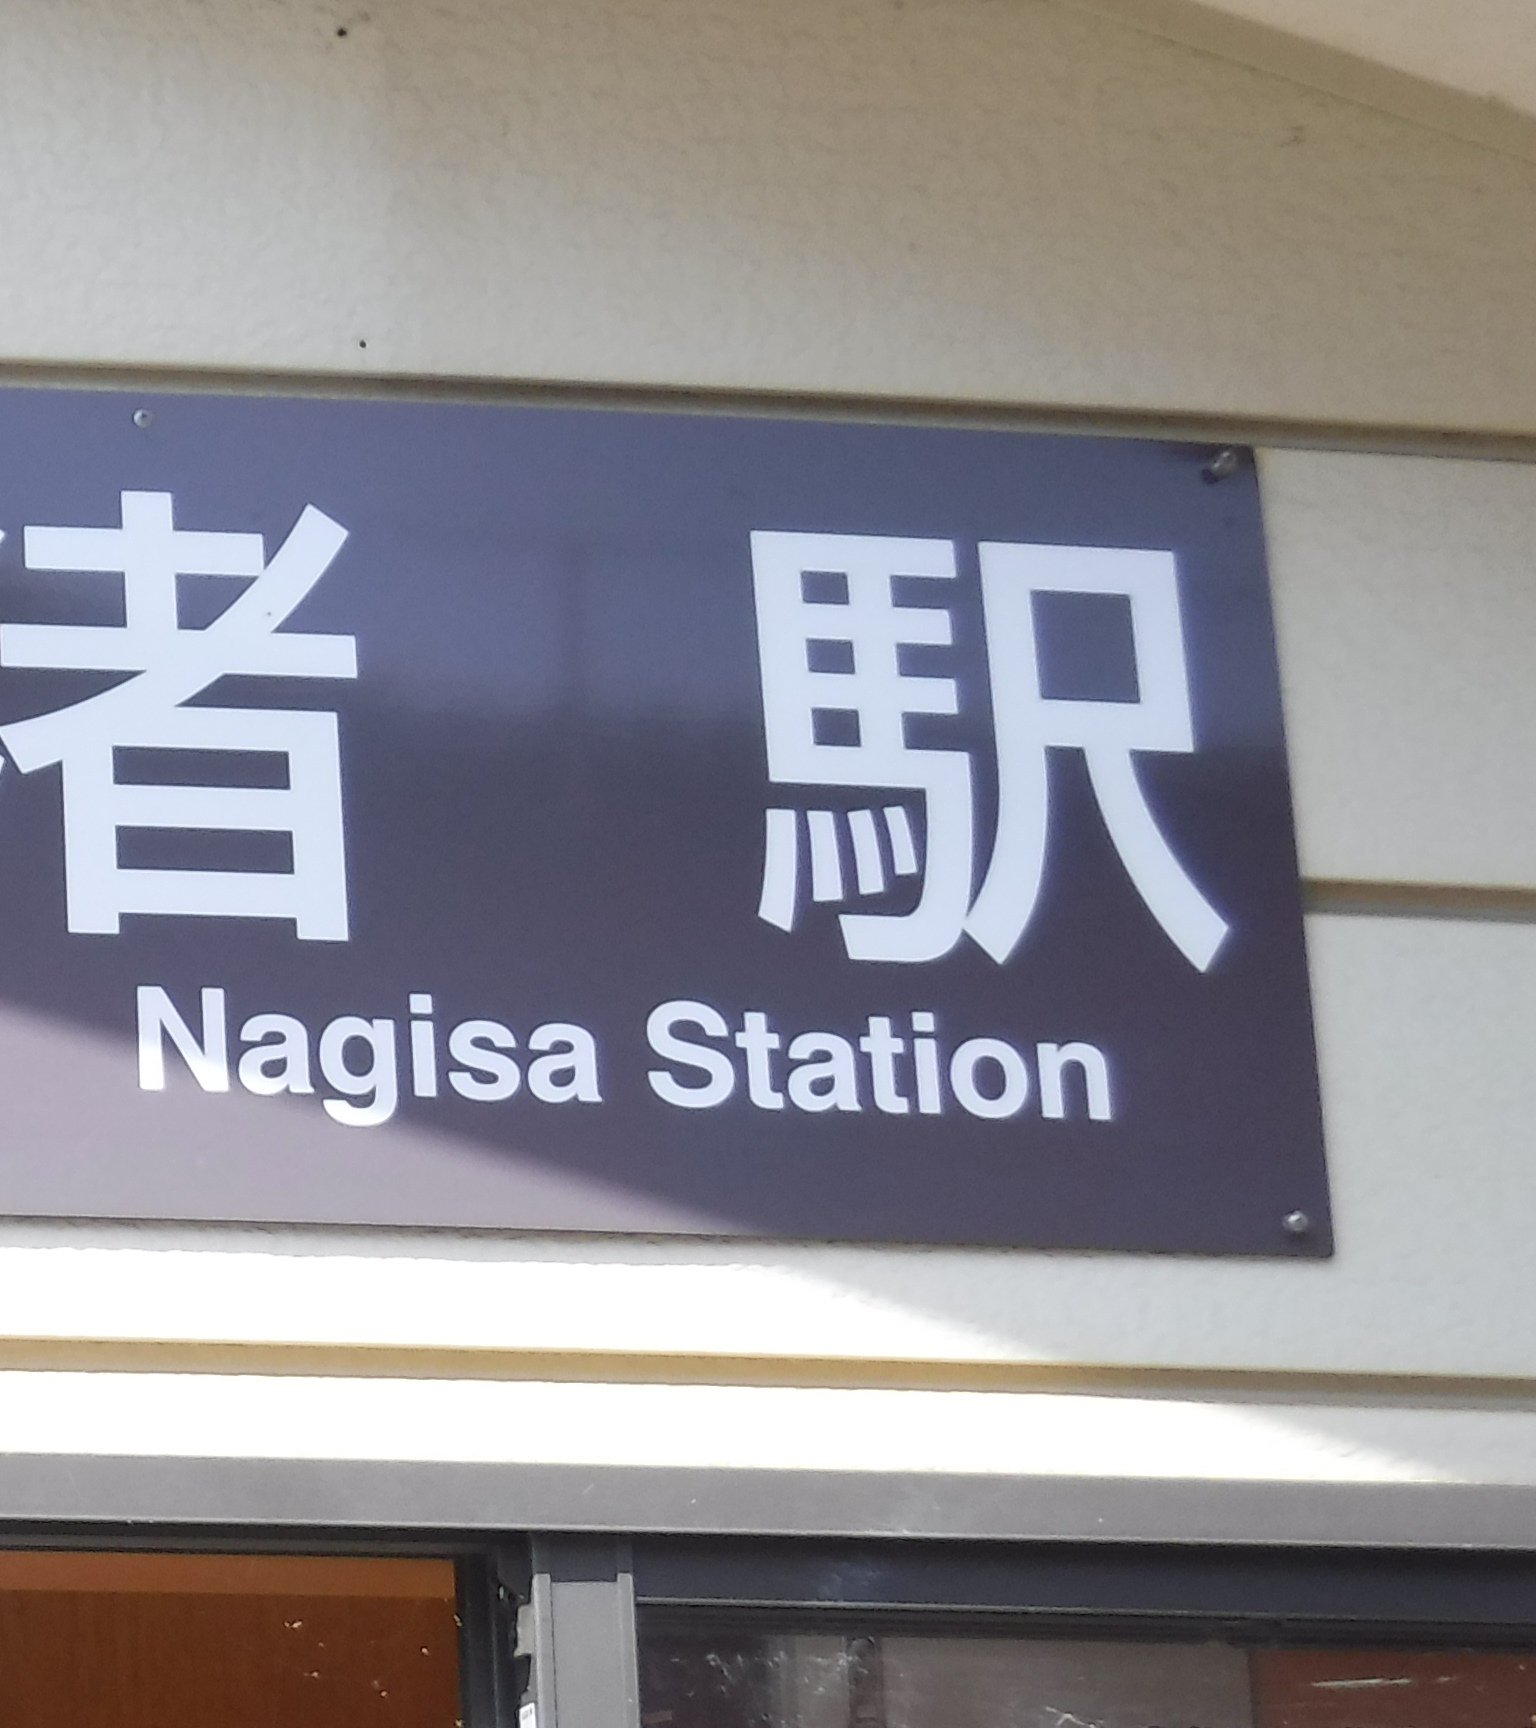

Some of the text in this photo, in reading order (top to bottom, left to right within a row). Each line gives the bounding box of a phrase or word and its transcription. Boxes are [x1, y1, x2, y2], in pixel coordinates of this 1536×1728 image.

[748, 529, 1230, 973] 駅
[135, 986, 1112, 1125] Nagisa Station
